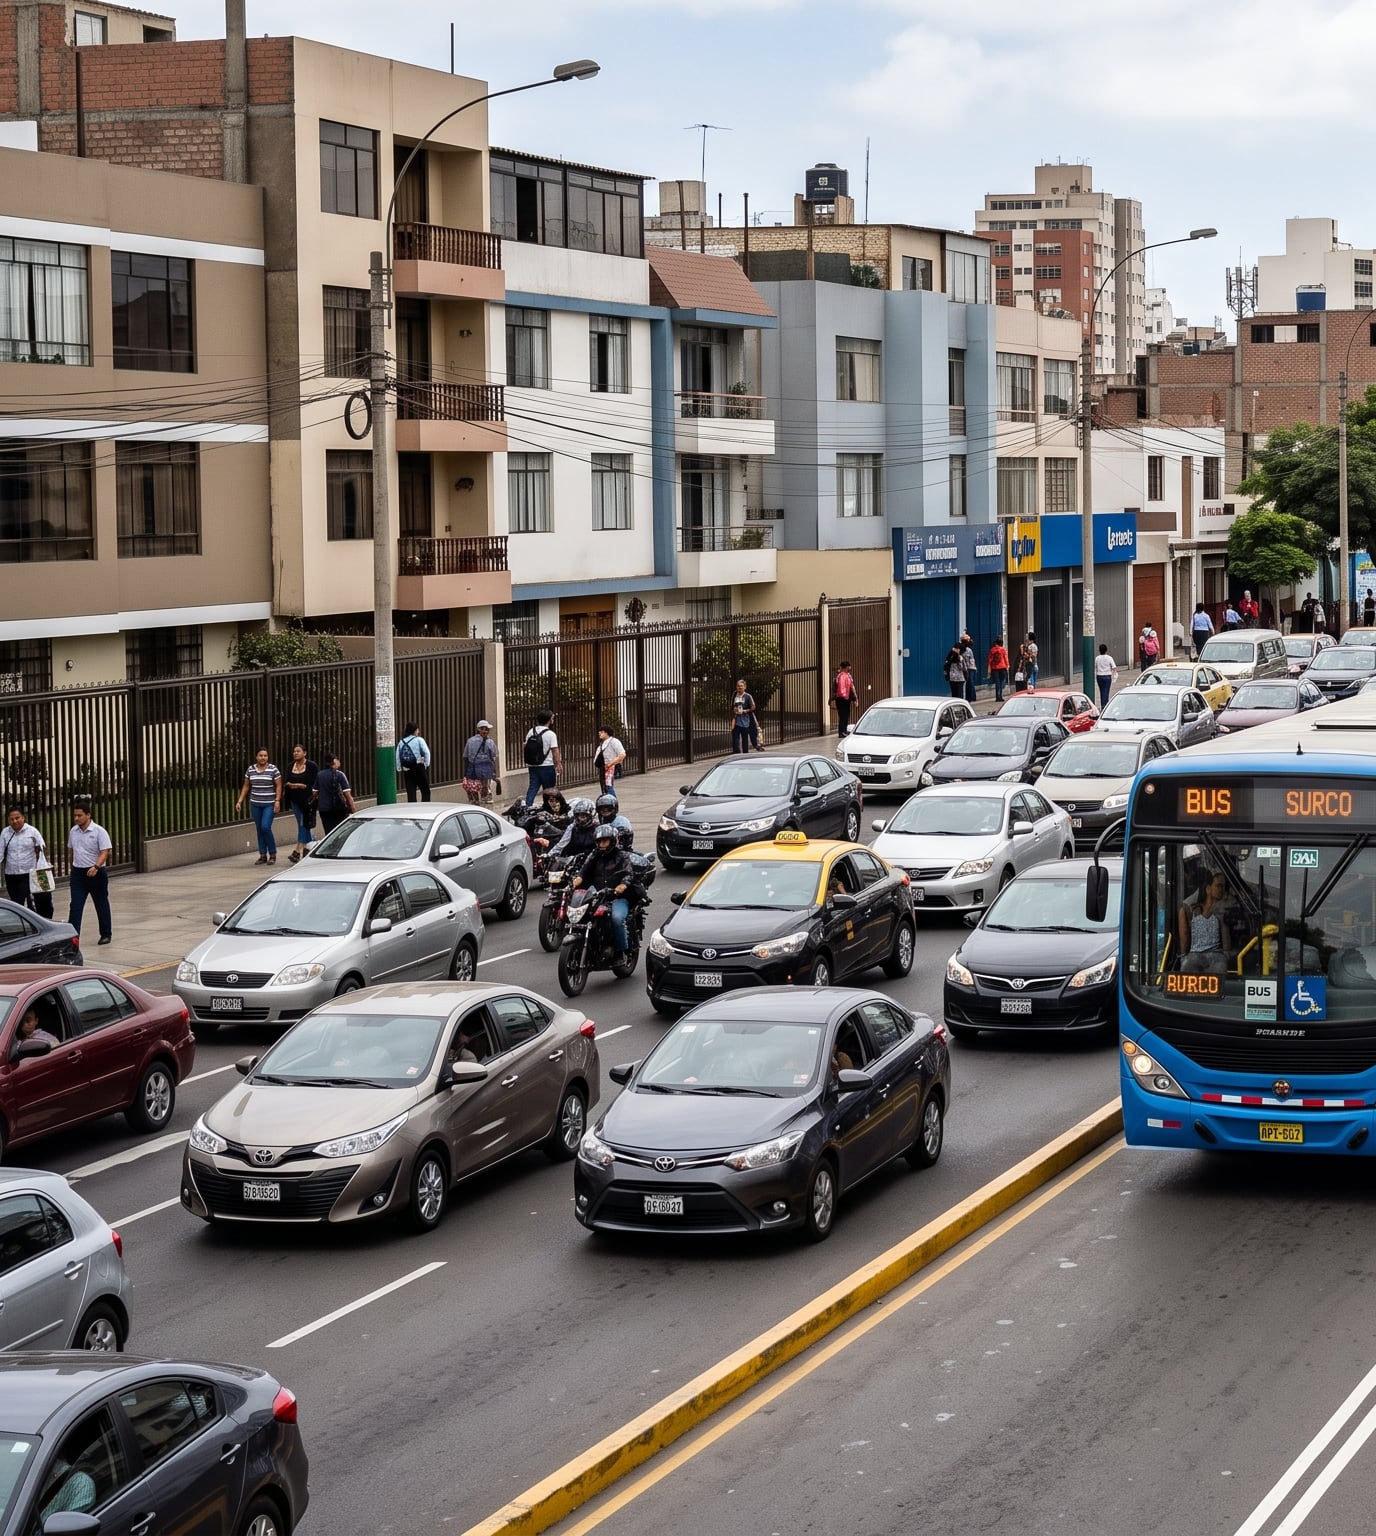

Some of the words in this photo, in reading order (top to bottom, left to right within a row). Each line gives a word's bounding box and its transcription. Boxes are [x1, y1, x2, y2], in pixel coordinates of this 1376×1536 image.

[1186, 788, 1231, 815] BUS
[1286, 790, 1352, 817] SURCO
[1247, 986, 1271, 997] BUS
